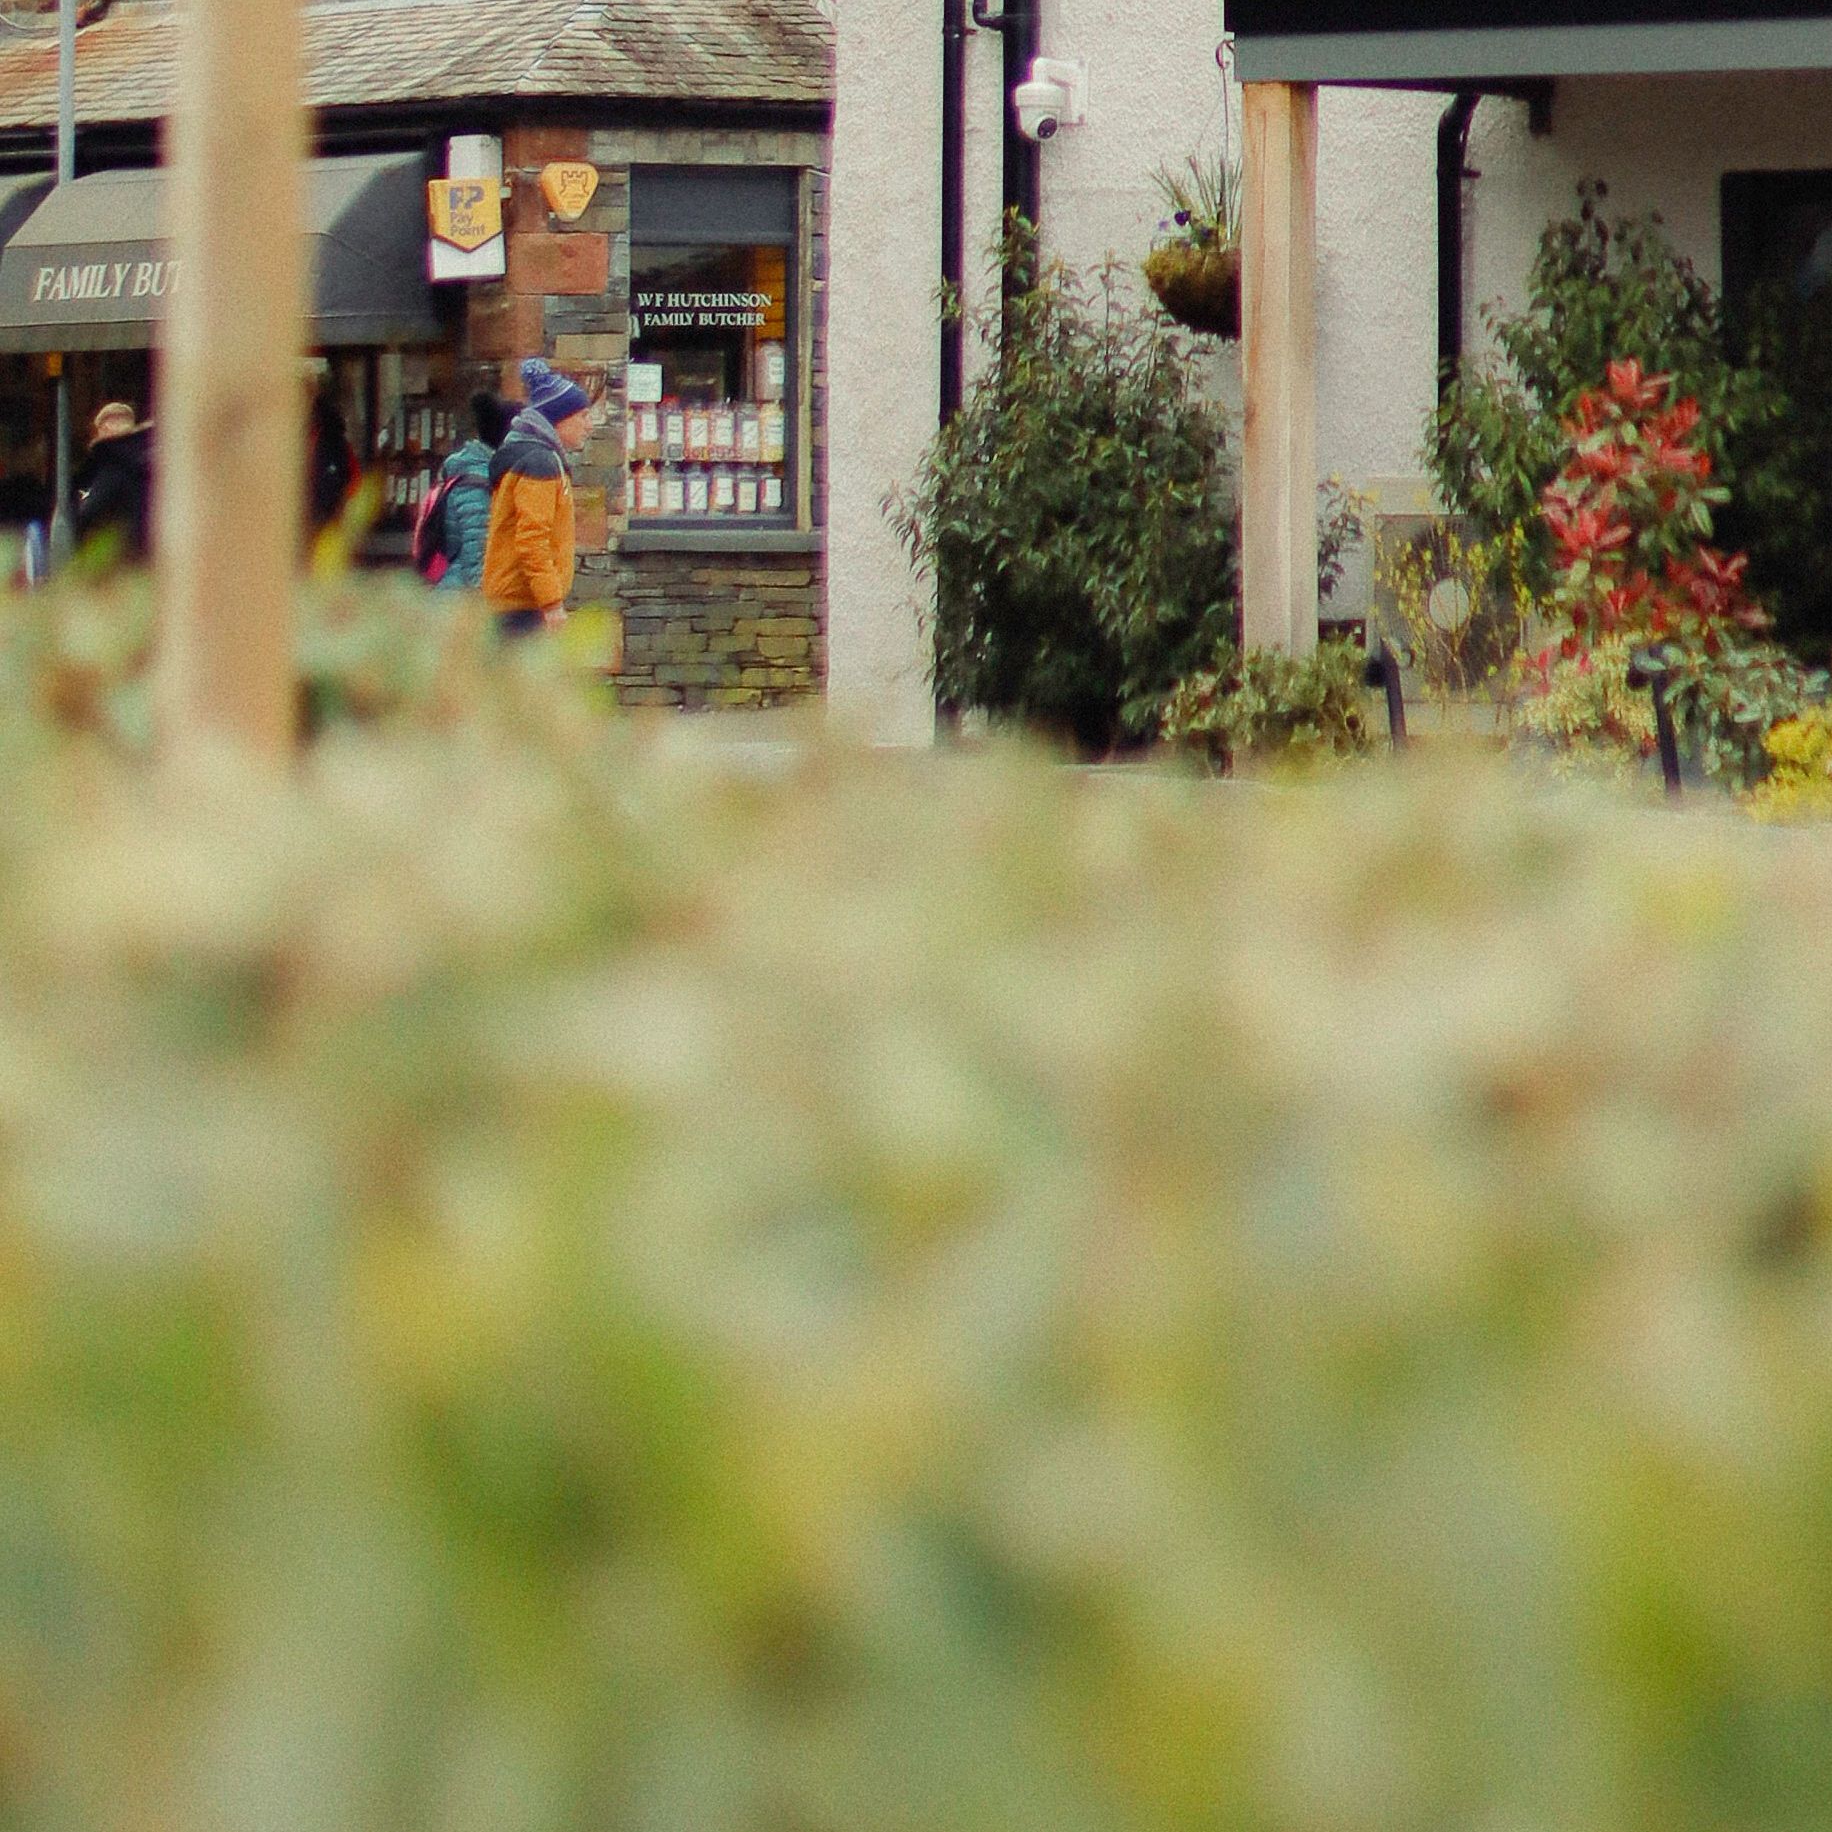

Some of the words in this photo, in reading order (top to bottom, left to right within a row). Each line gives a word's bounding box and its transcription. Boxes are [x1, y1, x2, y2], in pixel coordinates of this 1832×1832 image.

[450, 211, 473, 225] Pay
[450, 224, 486, 236] Point
[33, 262, 132, 302] FAMILY
[667, 293, 772, 307] HUTCHINSON
[644, 312, 694, 326] FAMILY
[699, 312, 766, 326] BUTCHER
